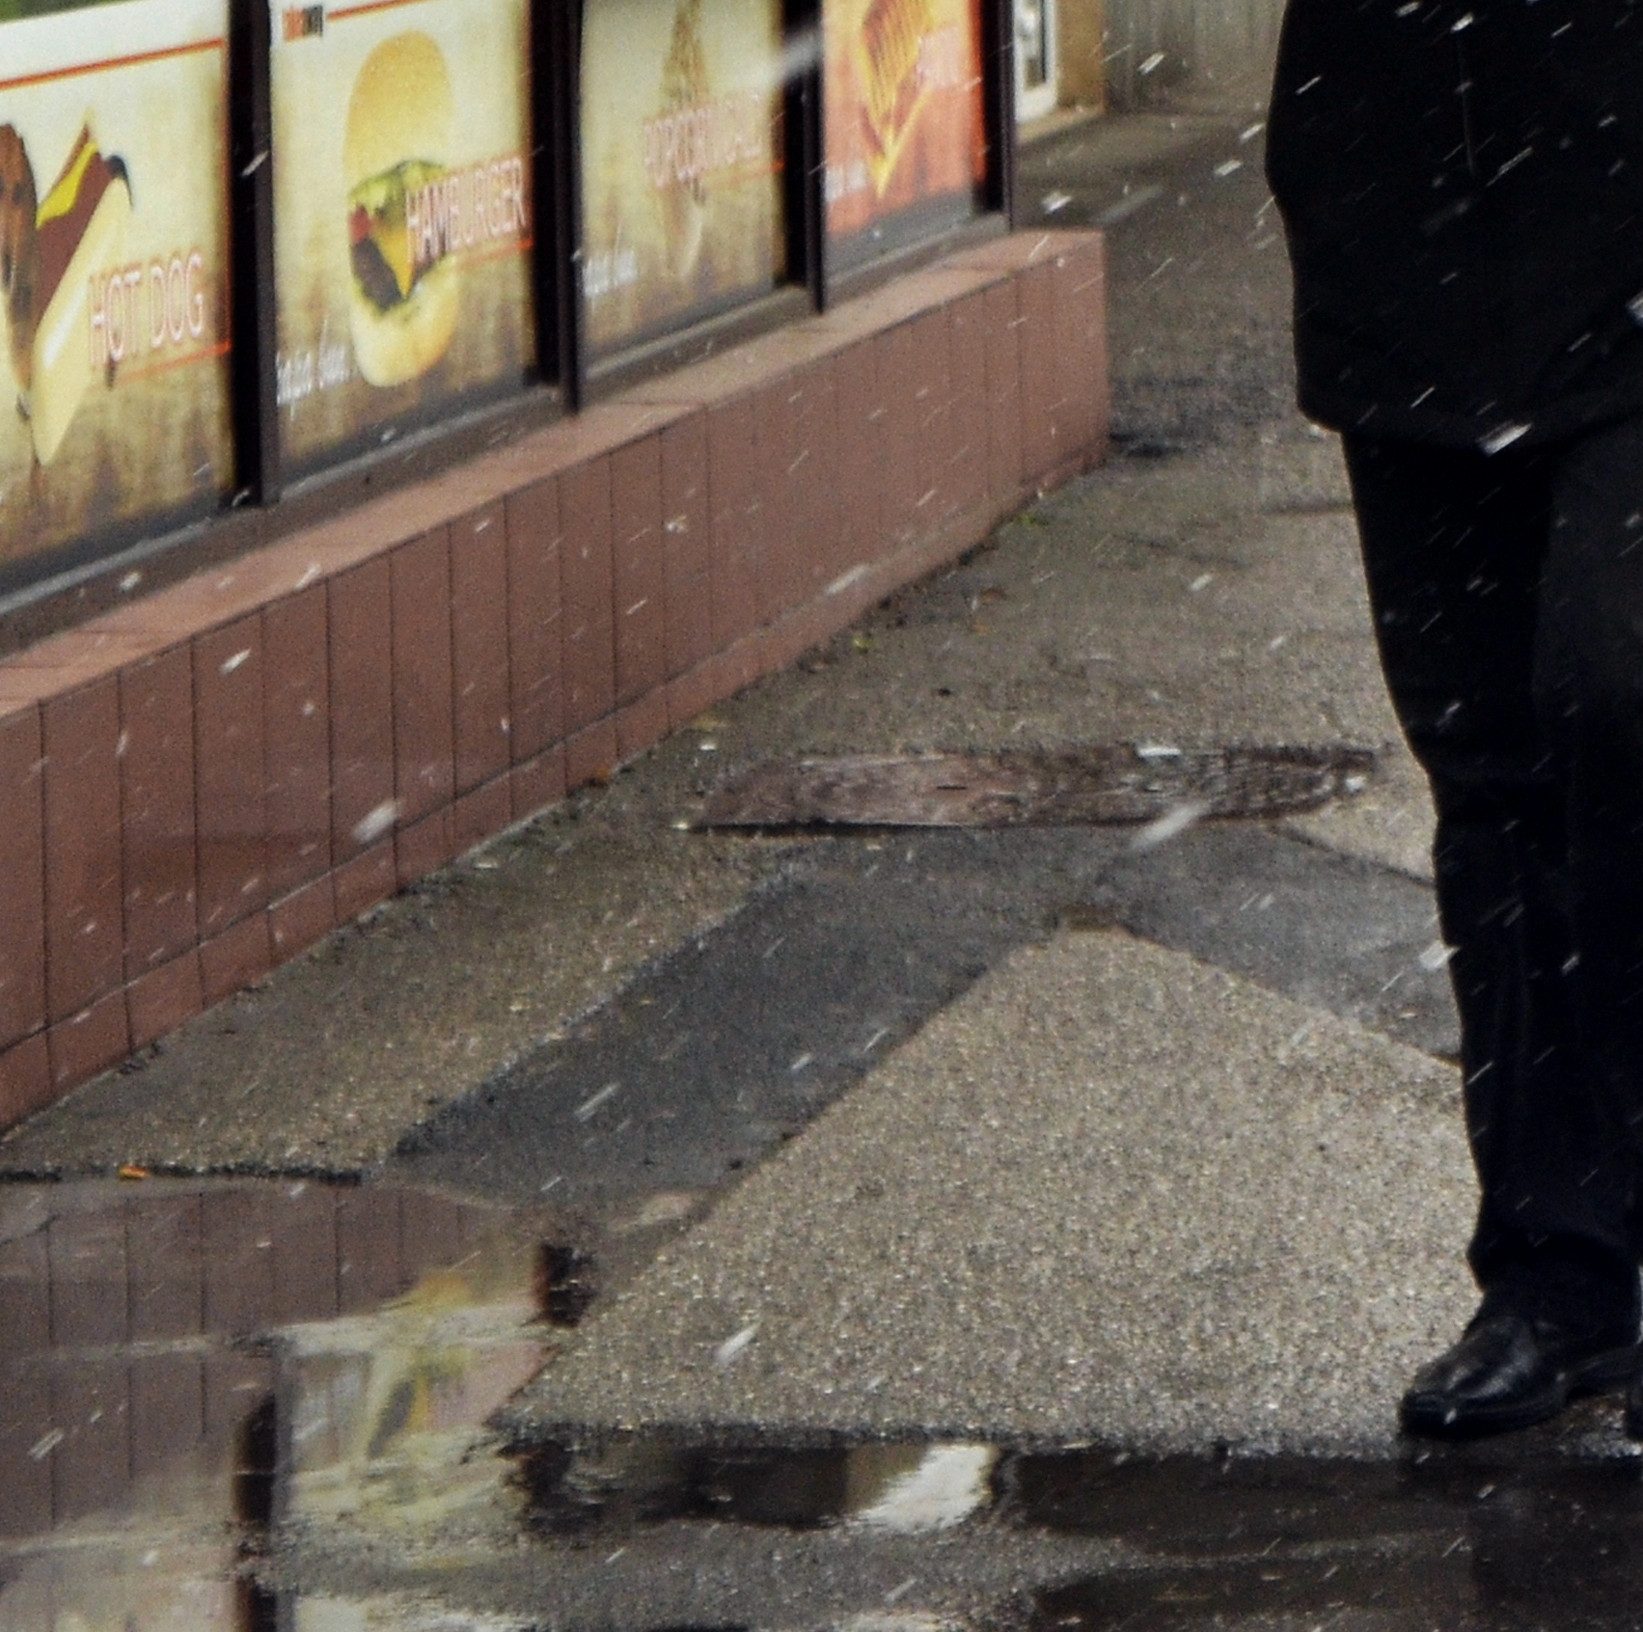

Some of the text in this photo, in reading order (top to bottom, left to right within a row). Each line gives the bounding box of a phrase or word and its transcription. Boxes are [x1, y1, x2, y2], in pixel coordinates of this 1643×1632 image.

[405, 156, 526, 264] HAMBURGER
[91, 252, 204, 365] HOT DOG
